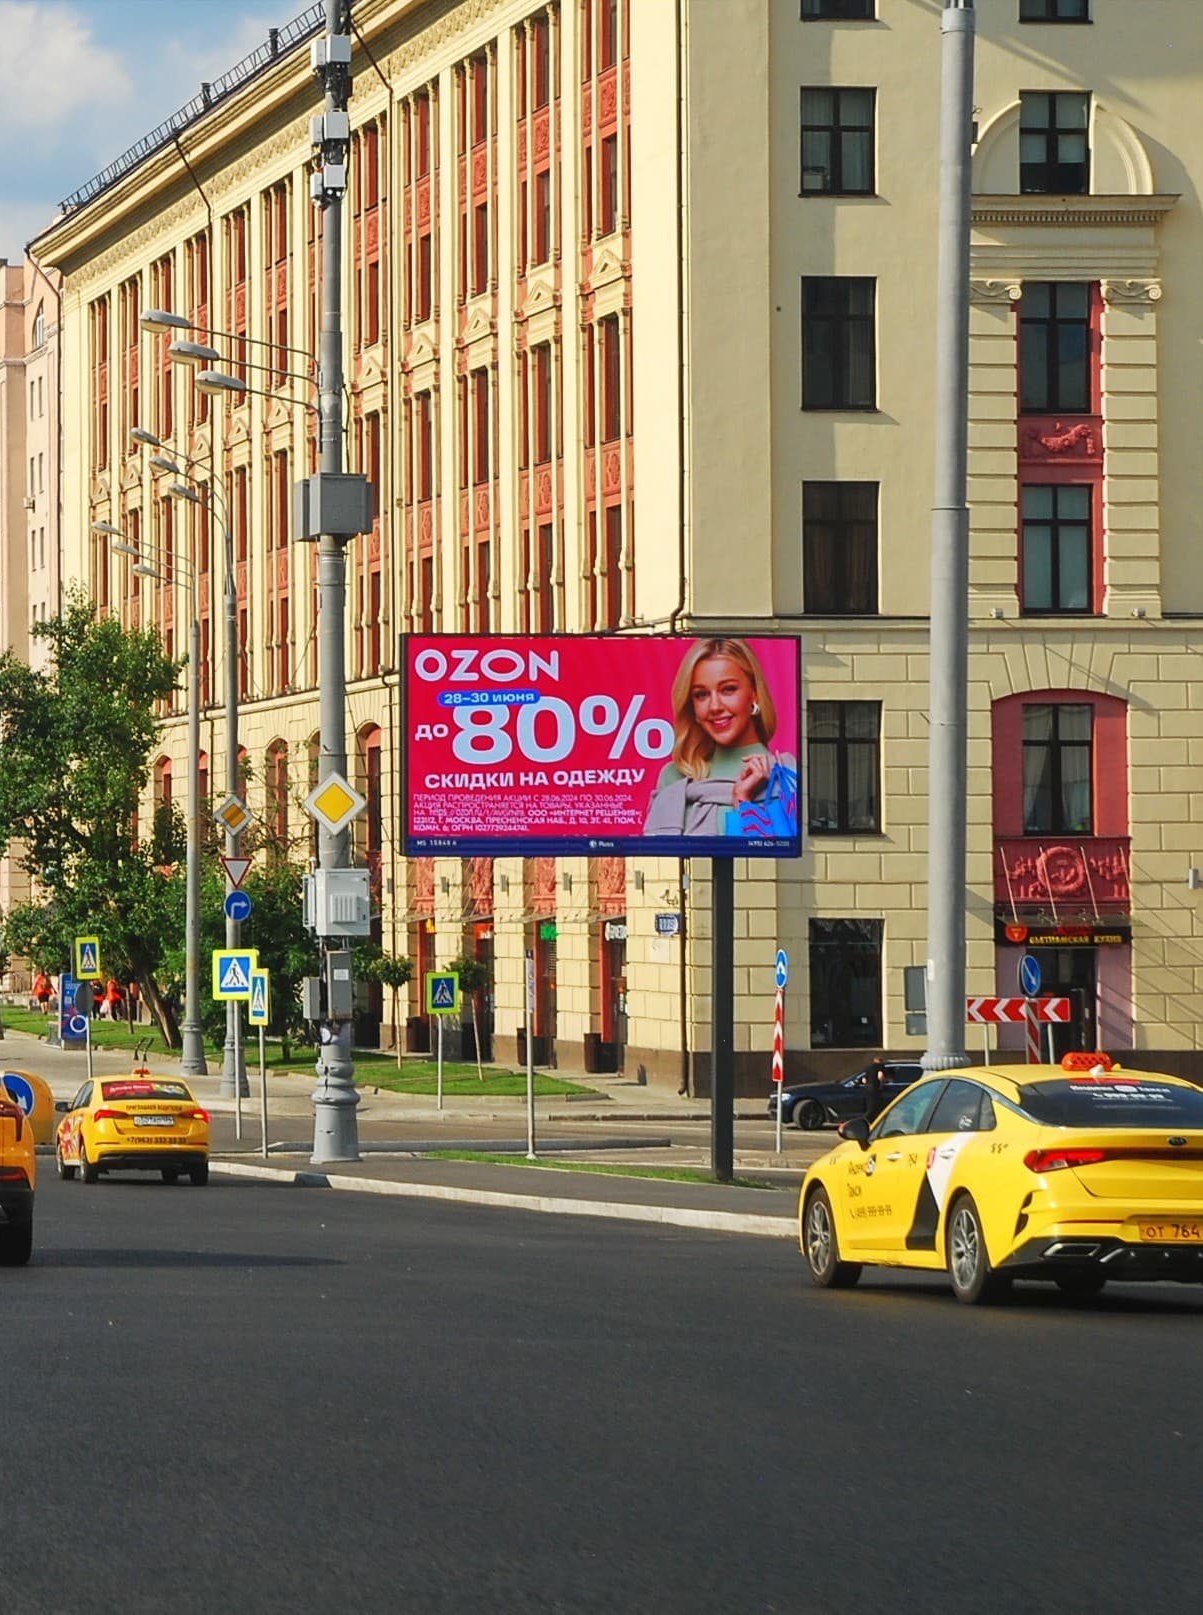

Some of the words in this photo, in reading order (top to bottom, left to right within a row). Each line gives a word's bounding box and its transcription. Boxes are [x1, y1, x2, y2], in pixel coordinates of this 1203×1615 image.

[414, 648, 560, 683] OZON
[492, 692, 535, 704] июня
[414, 722, 449, 742] до
[451, 694, 676, 765] 80%
[424, 771, 514, 791] СКИДКИ
[519, 771, 548, 788] НА
[552, 768, 646, 788] ОДЕЖДУ
[413, 793, 446, 802] ПЕРИОД
[447, 793, 502, 802] ПРОВЕДЕНИЯ
[503, 793, 532, 802] АКЦИИ
[579, 793, 593, 801] ПО
[413, 801, 441, 810] АКЦИЯ
[442, 801, 524, 809] РАСПРОСТРАНЯЕТСЯ
[525, 801, 538, 809] НА
[574, 801, 624, 809] УКАЗАННЫЕ
[413, 809, 425, 817] НА
[527, 809, 548, 817] ООО
[445, 816, 484, 825] МОСКВА,
[485, 816, 545, 825] ПРЕСНЕНСКАЯ
[451, 824, 474, 832] ОГРН
[1171, 1223, 1201, 1238] 764
